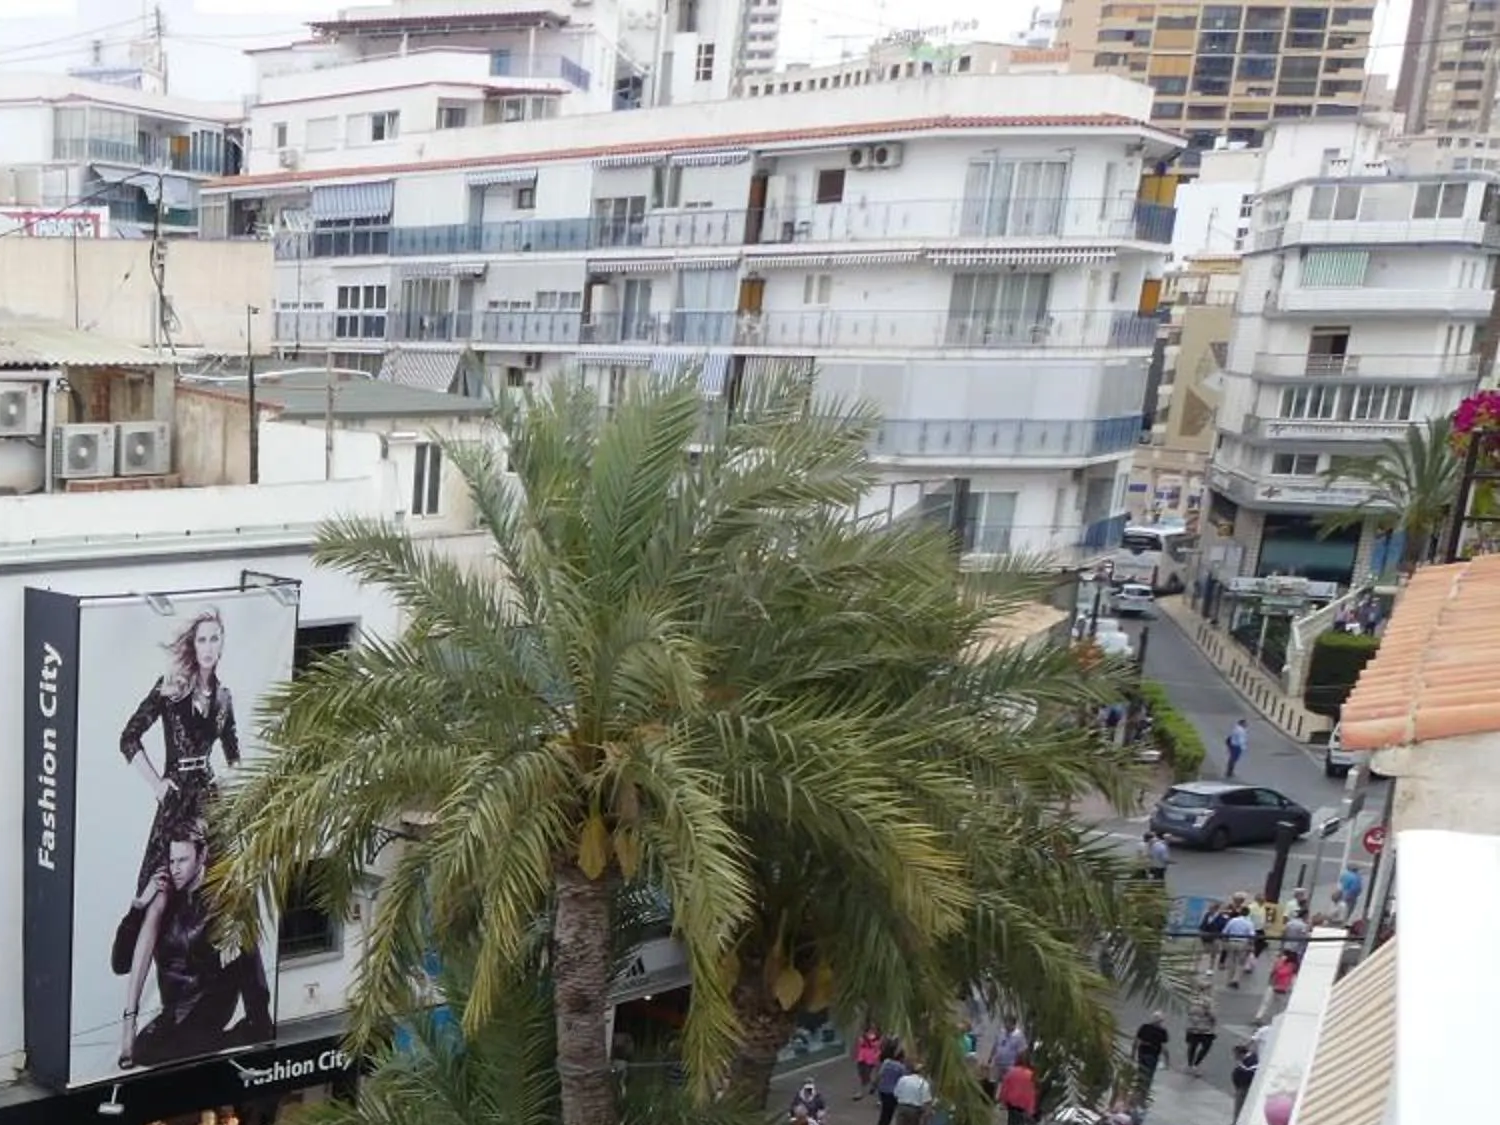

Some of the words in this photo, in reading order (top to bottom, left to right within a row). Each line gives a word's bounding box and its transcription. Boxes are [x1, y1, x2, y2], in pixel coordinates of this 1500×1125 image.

[39, 642, 63, 718] City
[37, 727, 58, 871] Fashion
[241, 1059, 315, 1089] shion
[318, 1049, 351, 1072] City
